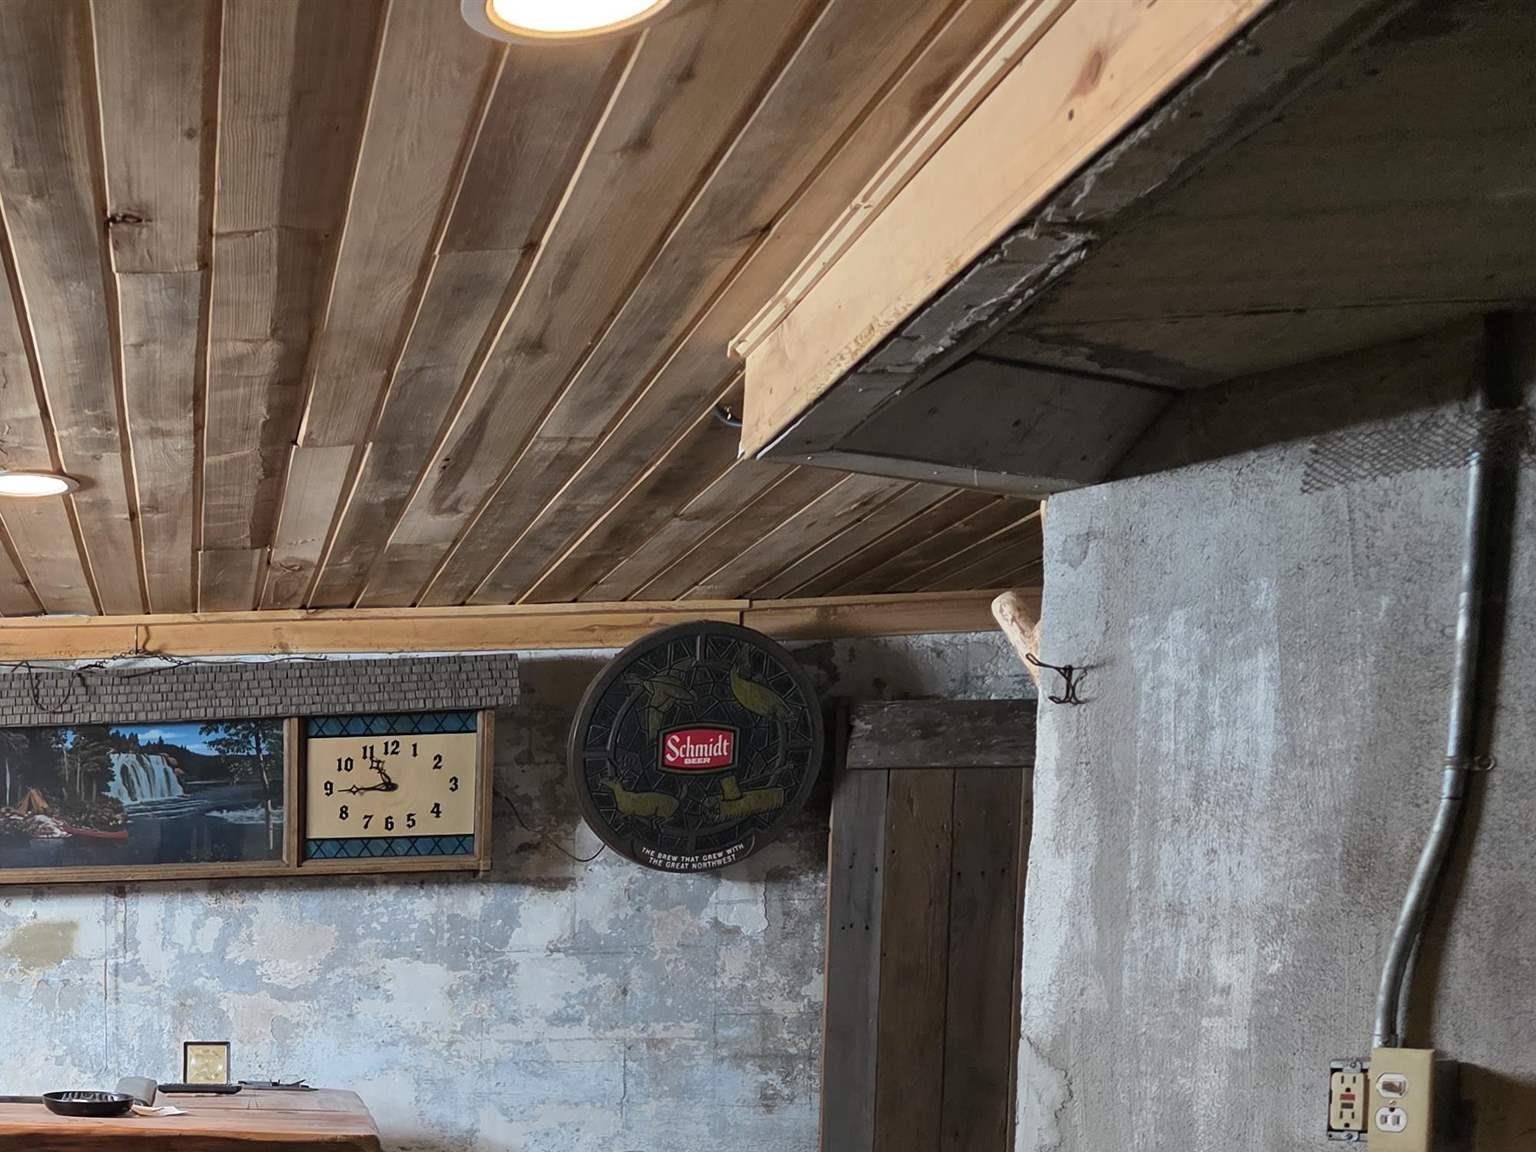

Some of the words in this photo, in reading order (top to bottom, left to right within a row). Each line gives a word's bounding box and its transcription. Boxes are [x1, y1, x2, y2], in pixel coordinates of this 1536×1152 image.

[362, 744, 375, 760] 11
[383, 740, 400, 756] 12
[412, 742, 418, 757] 1
[665, 734, 730, 762] Schmidt
[336, 757, 354, 772] 10
[432, 754, 443, 769] 2
[684, 757, 711, 765] BEER
[323, 780, 334, 796] 9
[449, 776, 459, 792] 3
[339, 804, 349, 820] 8
[430, 802, 442, 818] 4
[363, 814, 373, 829] 7
[384, 815, 394, 831] 6
[406, 813, 416, 829] 5
[642, 847, 655, 857] THE
[657, 852, 678, 862] BREW
[702, 852, 724, 861] GREW
[726, 843, 744, 855] WITH
[649, 857, 663, 867] THE
[665, 862, 689, 870] GREAT
[692, 854, 737, 870] NORTHWEST
